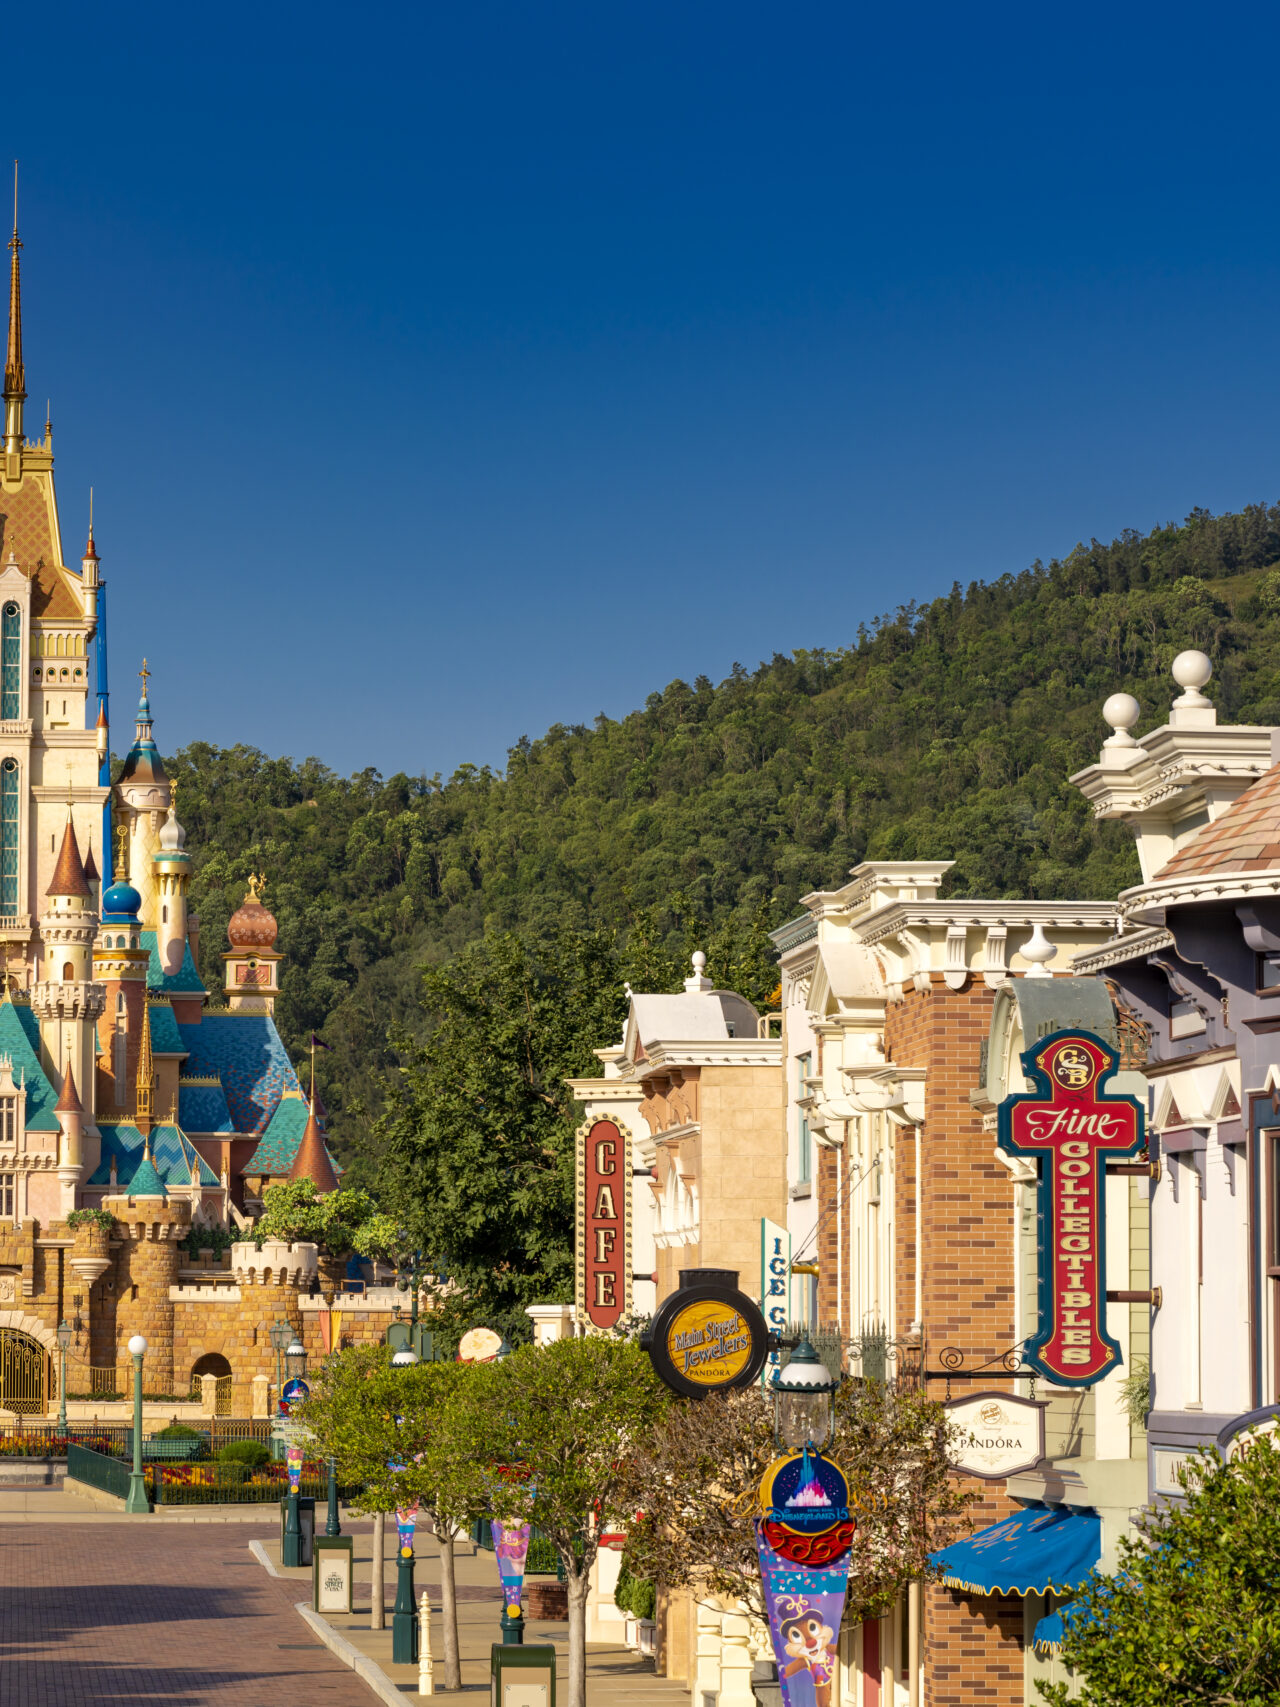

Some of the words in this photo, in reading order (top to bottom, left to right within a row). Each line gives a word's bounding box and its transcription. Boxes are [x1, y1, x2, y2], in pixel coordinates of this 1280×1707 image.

[1026, 1107, 1128, 1140] Fine
[592, 1140, 619, 1307] CAFE
[769, 1237, 786, 1297] ICE
[674, 1327, 704, 1352] Main
[705, 1313, 739, 1343] Street
[683, 1334, 749, 1374] Jewelers
[960, 1438, 1023, 1449] PANDORA
[836, 1507, 849, 1521] 15
